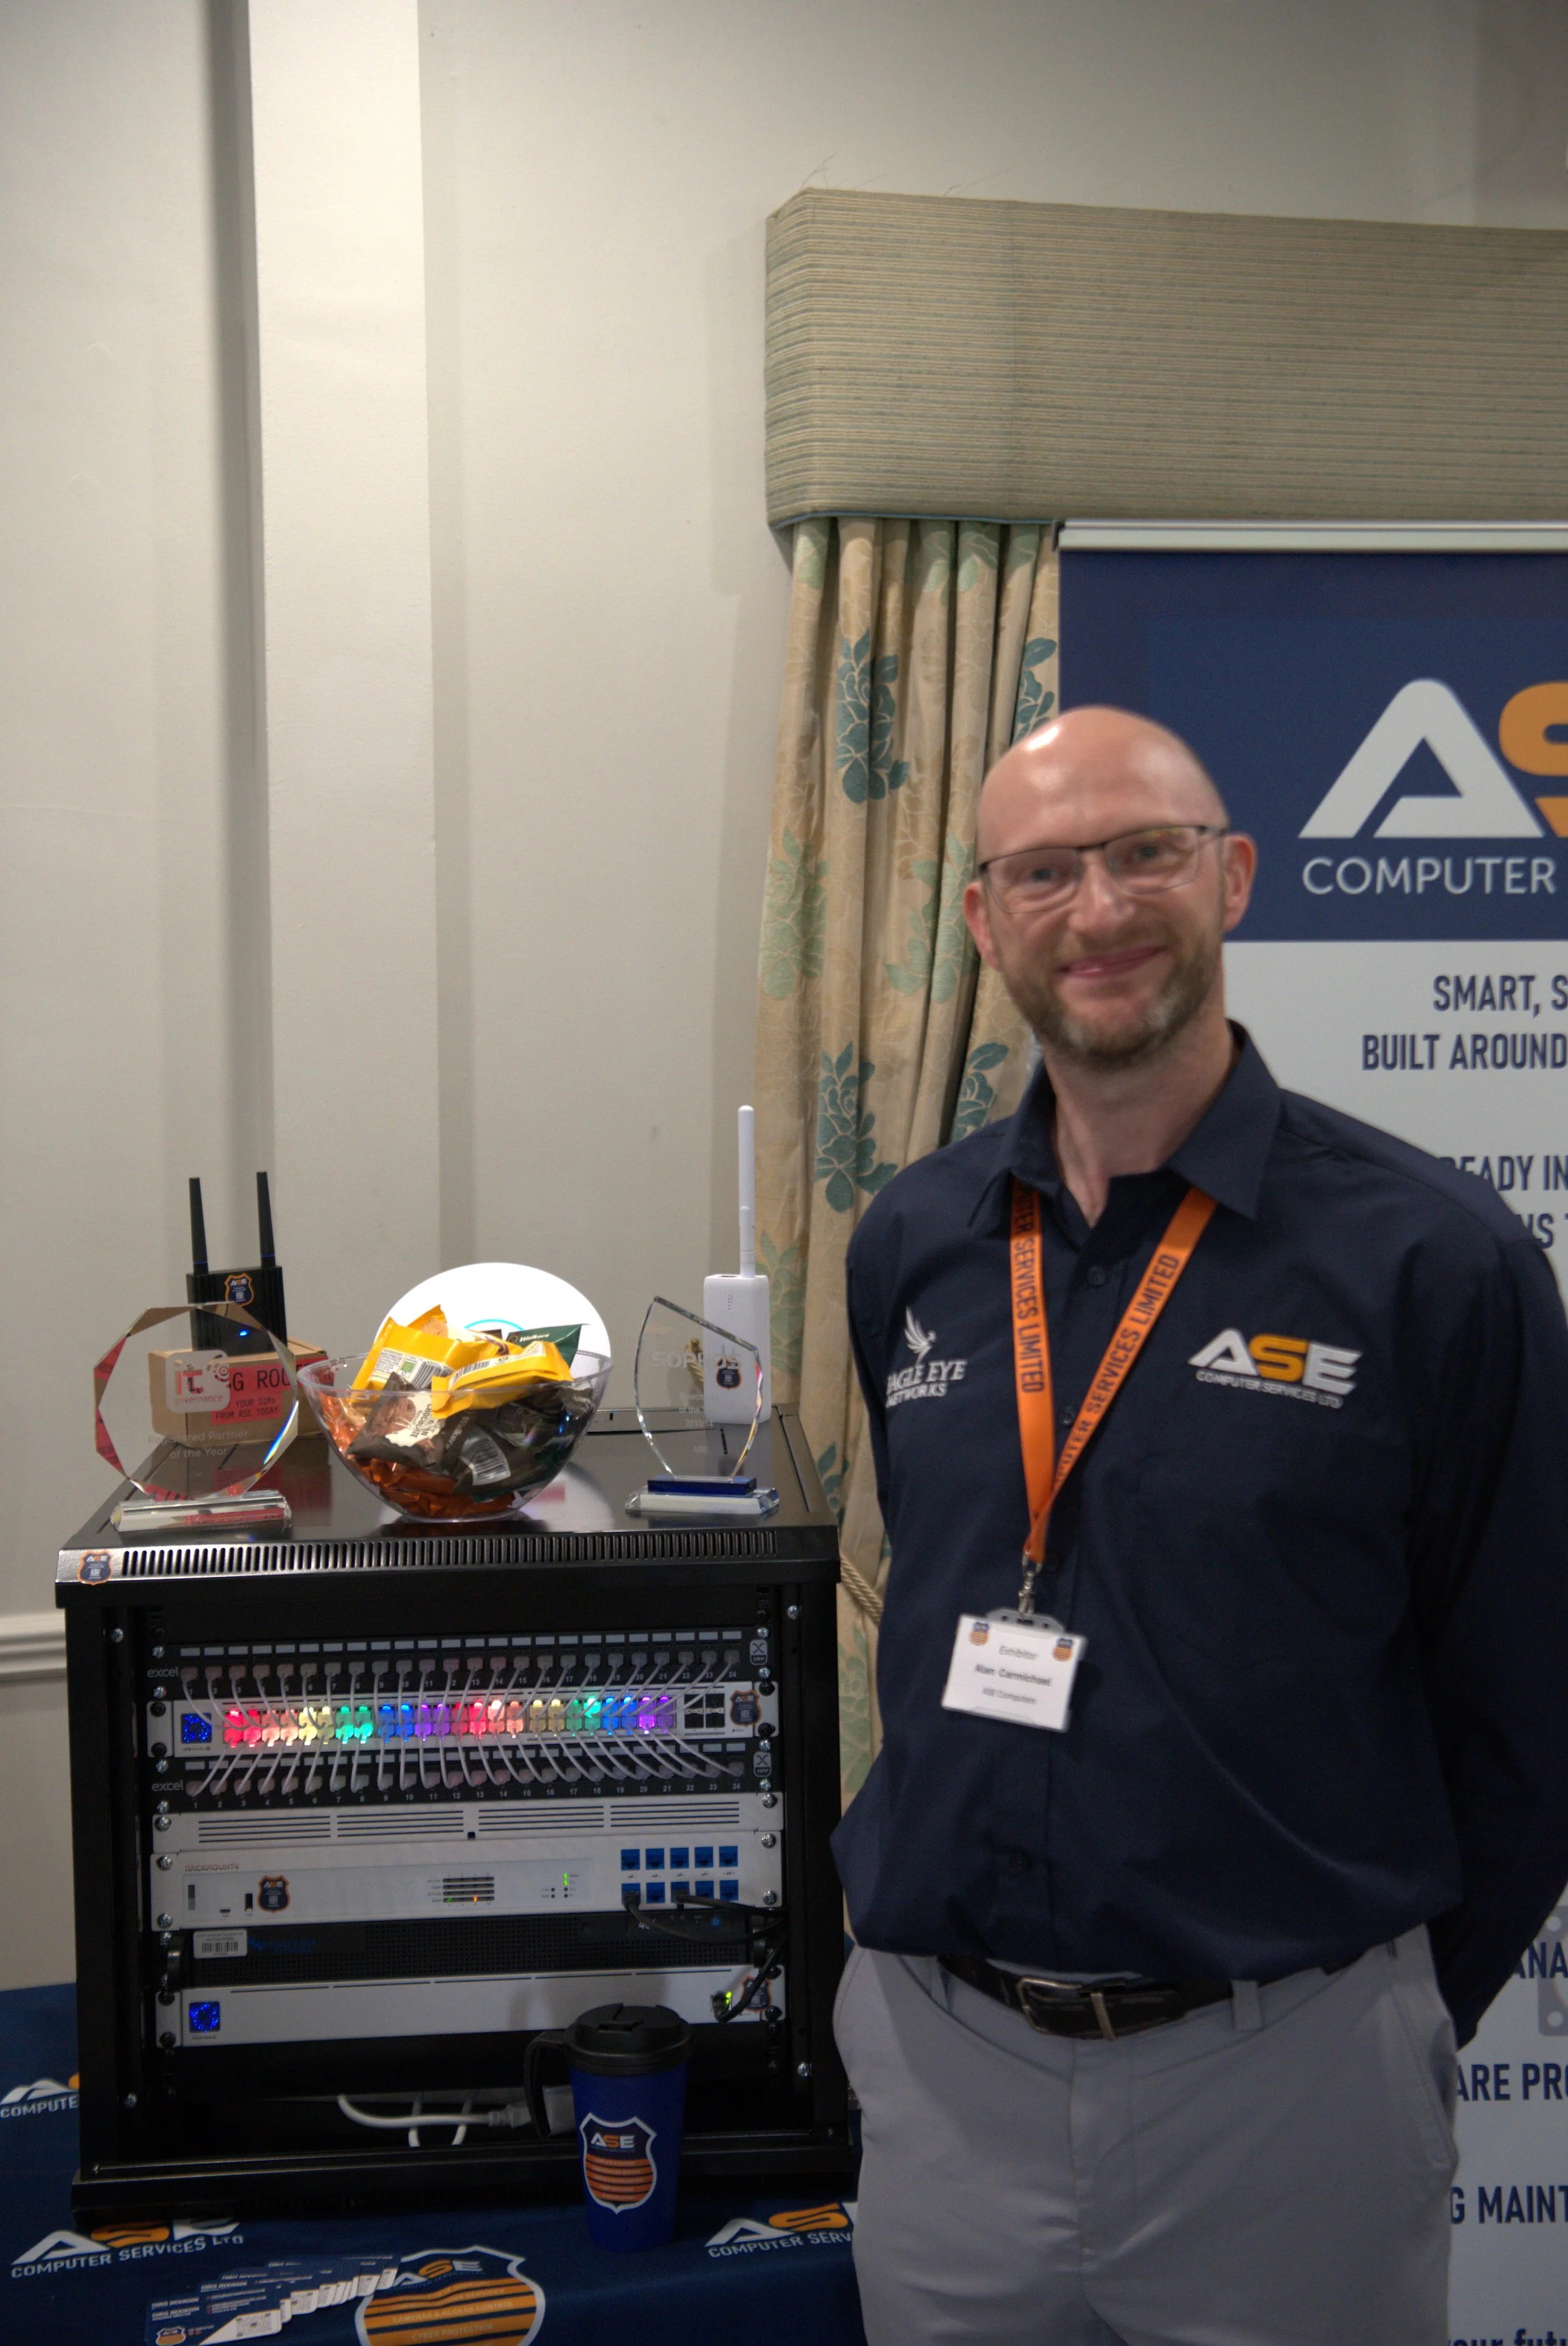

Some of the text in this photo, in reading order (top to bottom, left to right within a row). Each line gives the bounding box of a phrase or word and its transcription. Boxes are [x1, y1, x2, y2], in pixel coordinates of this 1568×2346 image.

[1302, 857, 1556, 895] COMPUTER
[1433, 975, 1540, 1019] SMART,
[1362, 1033, 1567, 1071] BUILT AROUND
[1014, 1237, 1039, 1320] SERVICES
[1087, 1328, 1141, 1413] SERVICES
[1134, 1253, 1180, 1325] LIMITED
[1017, 1322, 1046, 1393] LIMITED
[1187, 1327, 1364, 1396] ASE
[227, 1372, 244, 1392] G
[925, 1359, 968, 1383] EYE
[215, 1411, 234, 1420] FROM
[257, 1407, 278, 1416] TODAY
[236, 1399, 253, 1408] YOUR
[208, 1430, 249, 1441] Partner
[169, 1446, 229, 1459] of the Year
[147, 1667, 179, 1678] excel
[151, 1779, 184, 1792] excel
[1522, 2062, 1568, 2101] PR
[590, 2132, 635, 2149] ASE
[704, 2202, 859, 2248] AS
[11, 2234, 245, 2279] COMPUTER SERVICES LTD
[707, 2234, 804, 2259] COMPUTER
[393, 2259, 484, 2287] ASE
[440, 2306, 475, 2317] ACCESS
[475, 2300, 514, 2312] CONTROL
[411, 2323, 494, 2341] CYBER PROTECTION
